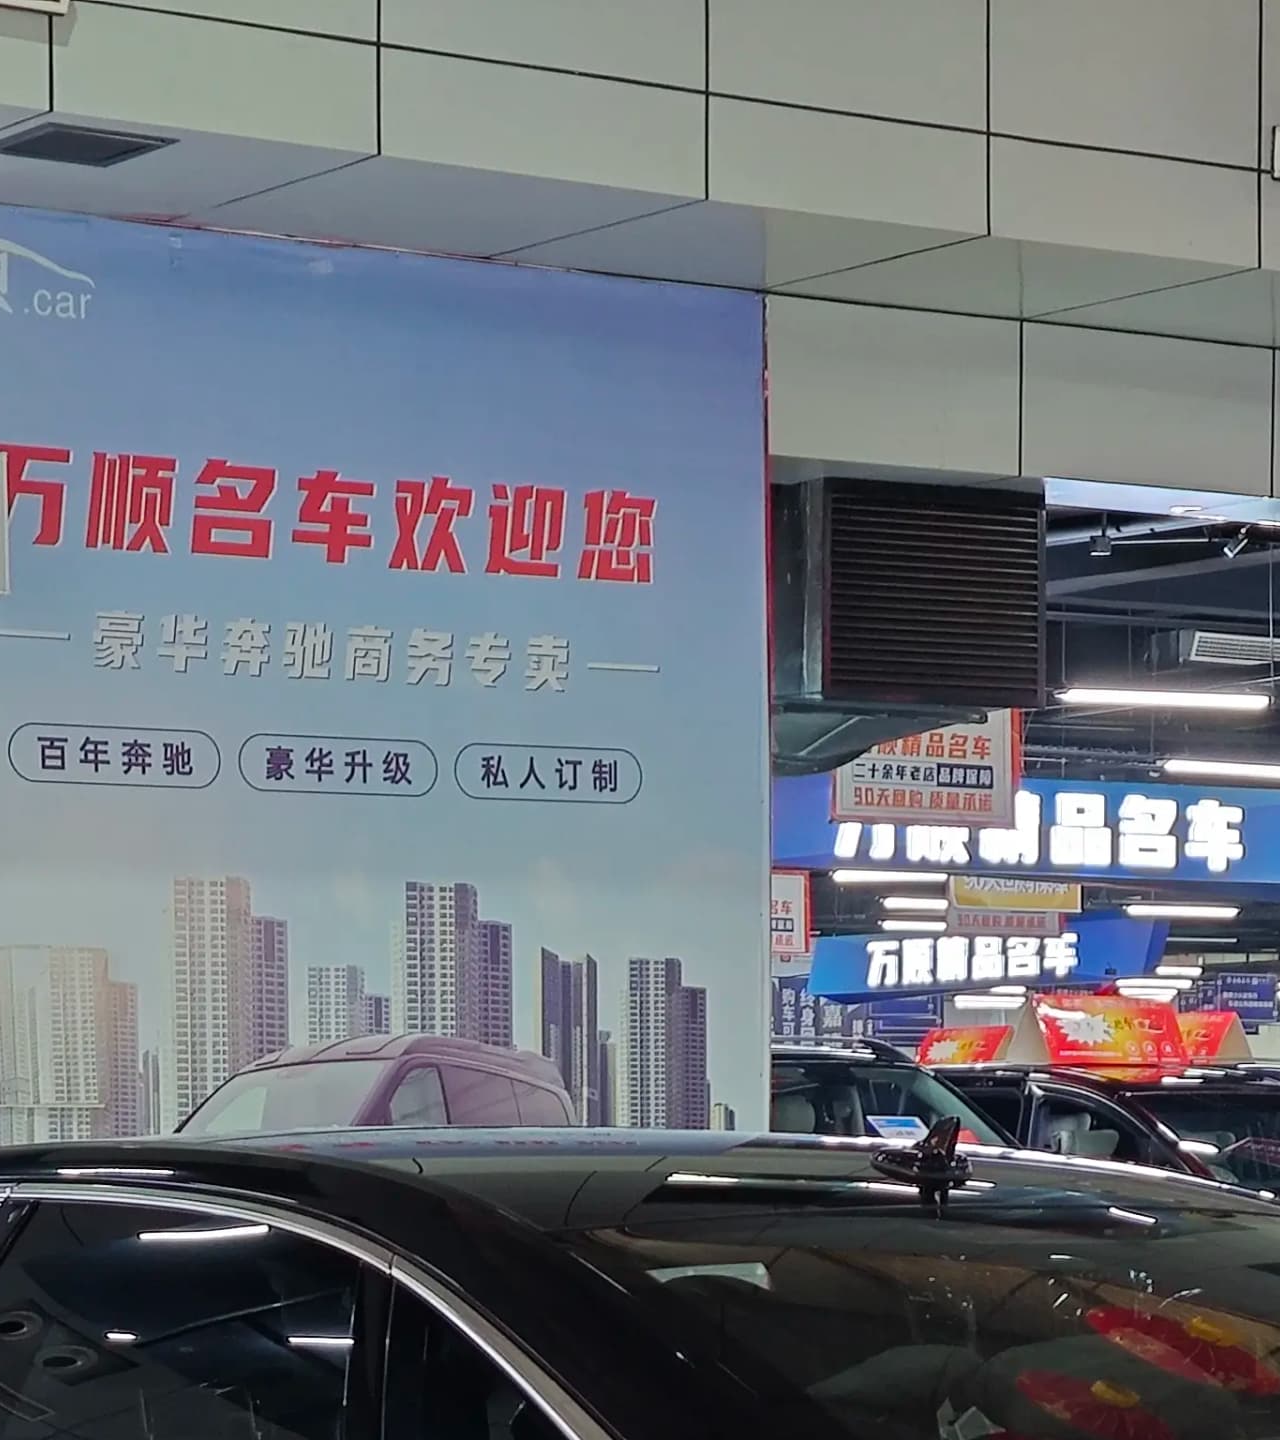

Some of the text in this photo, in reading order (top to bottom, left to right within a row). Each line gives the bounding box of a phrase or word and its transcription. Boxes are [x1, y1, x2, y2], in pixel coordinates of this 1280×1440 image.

[93, 611, 572, 692] 豪华奔驰商务专卖
[37, 736, 195, 780] 百年奔驰
[264, 748, 414, 788] 豪华升级
[481, 756, 621, 794] 私人订制
[854, 763, 935, 782] 二十余年老店
[854, 787, 923, 809] 90天回购
